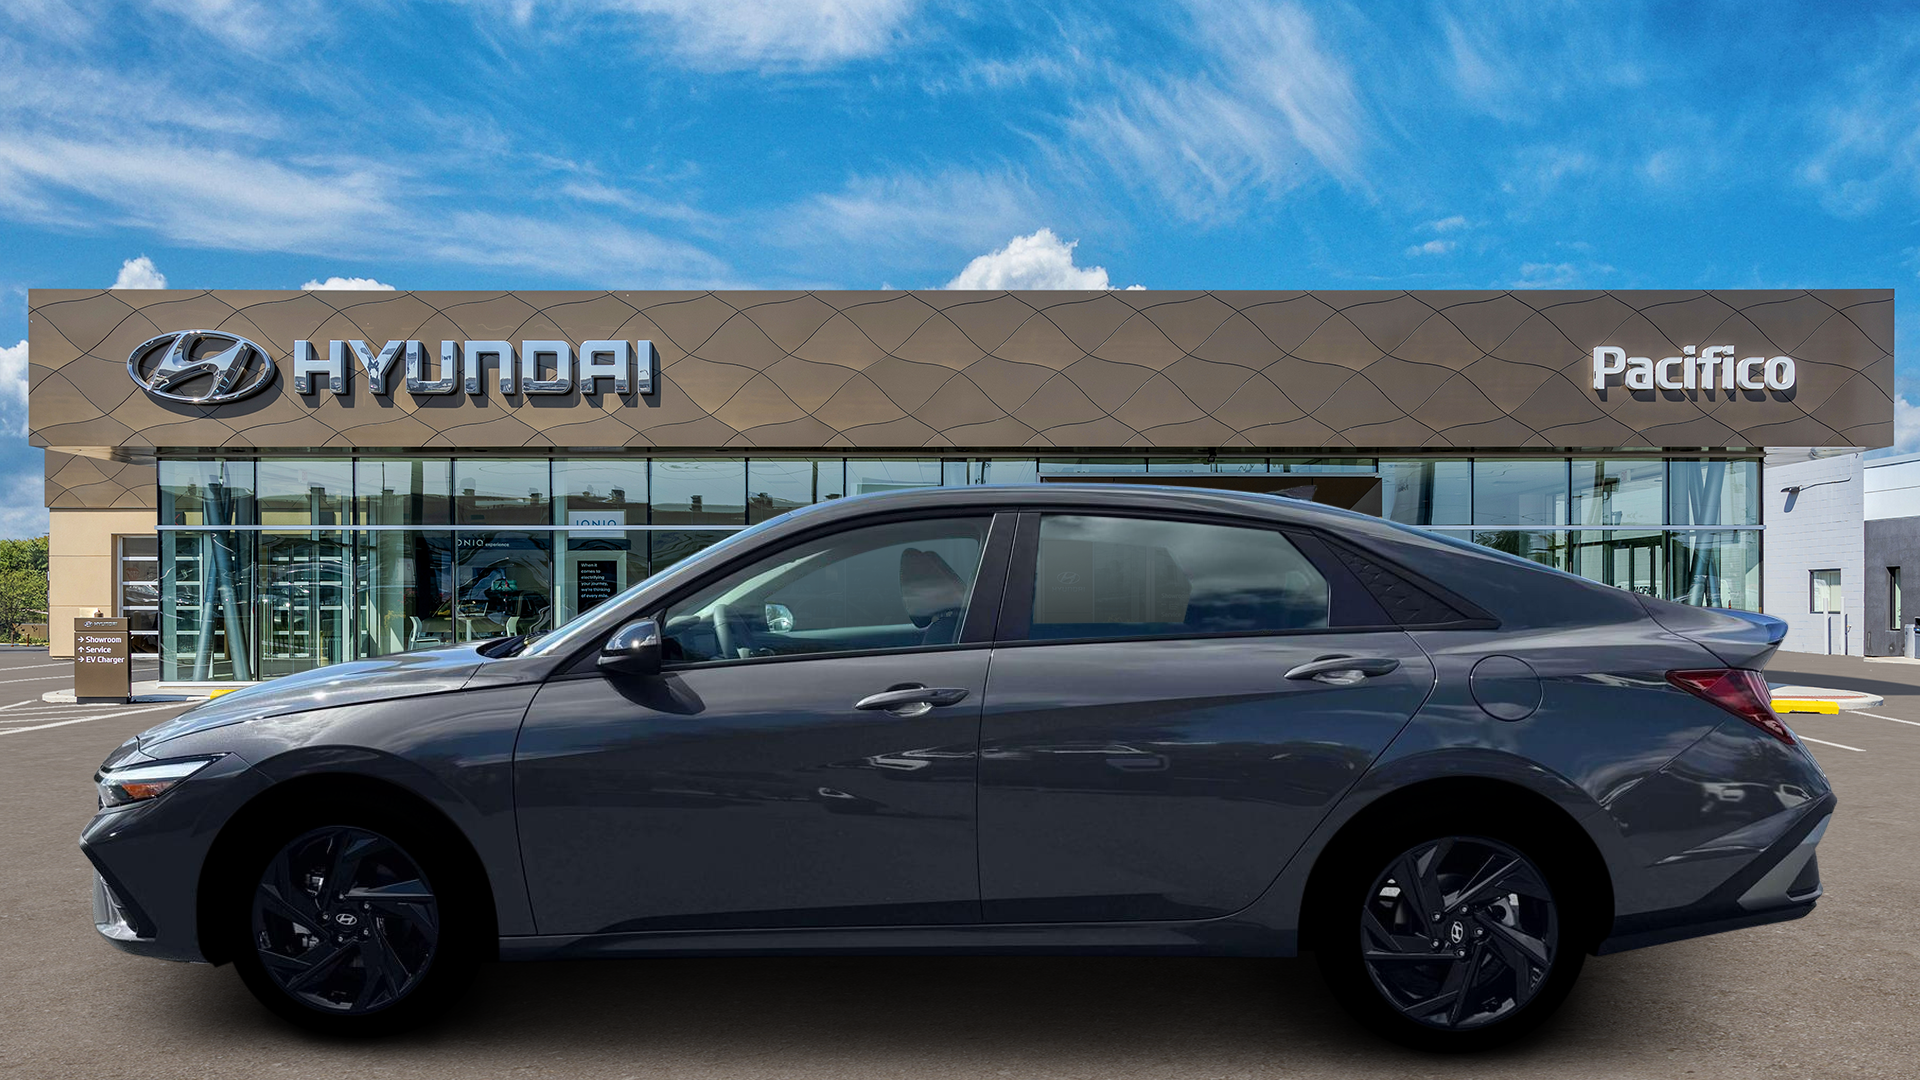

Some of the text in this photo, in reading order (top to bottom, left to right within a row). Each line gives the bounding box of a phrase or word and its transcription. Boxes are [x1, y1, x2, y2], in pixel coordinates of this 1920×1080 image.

[293, 340, 656, 395] HYUNDAI
[1593, 345, 1796, 391] Pacifico
[85, 646, 112, 654] Service
[97, 656, 125, 664] Charger
